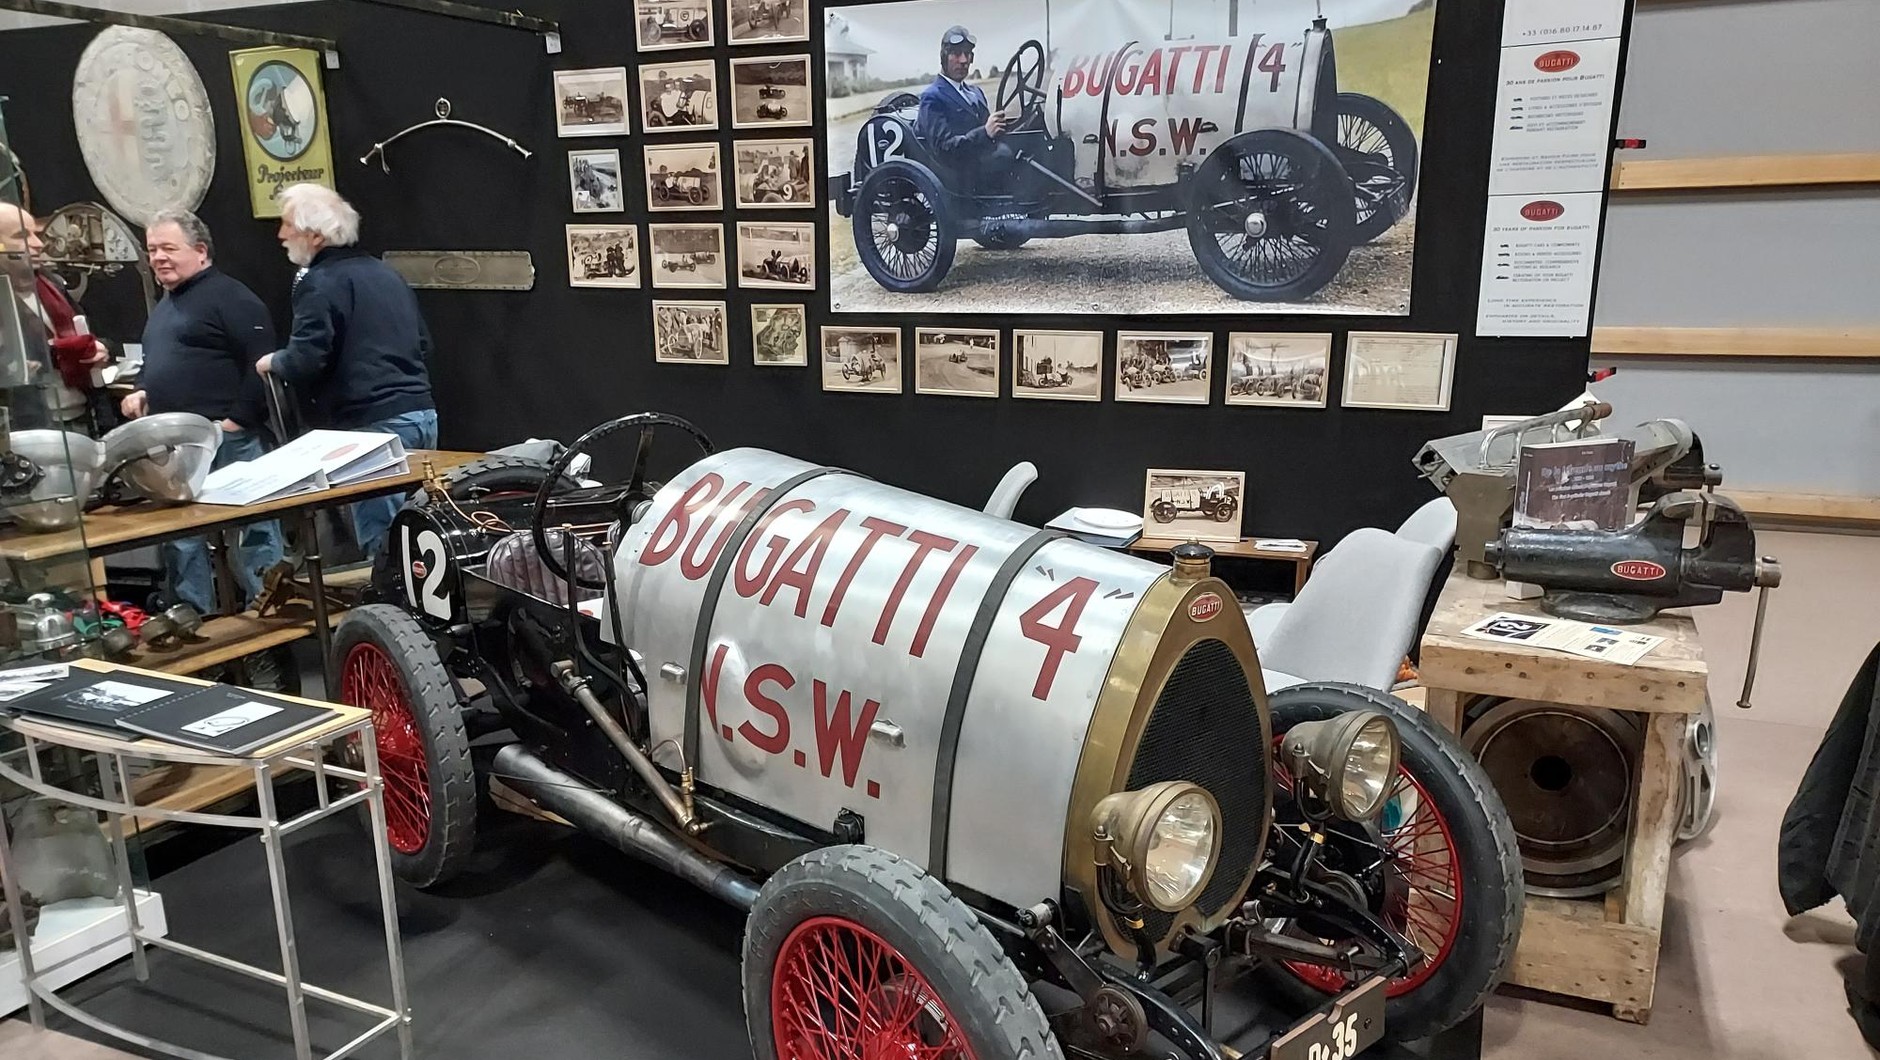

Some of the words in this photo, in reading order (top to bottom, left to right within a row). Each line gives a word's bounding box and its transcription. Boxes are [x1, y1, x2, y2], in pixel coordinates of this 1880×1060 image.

[1062, 44, 1233, 99] BUGATTI
[1539, 57, 1574, 68] BUGATTI
[867, 120, 906, 168] 12
[783, 183, 793, 201] 9
[1524, 208, 1559, 217] BUGATTI
[401, 525, 452, 621] 12
[638, 472, 980, 659] BUGATTI
[1617, 564, 1660, 576] BUGATTI
[1191, 600, 1220, 616] BUGATTI
